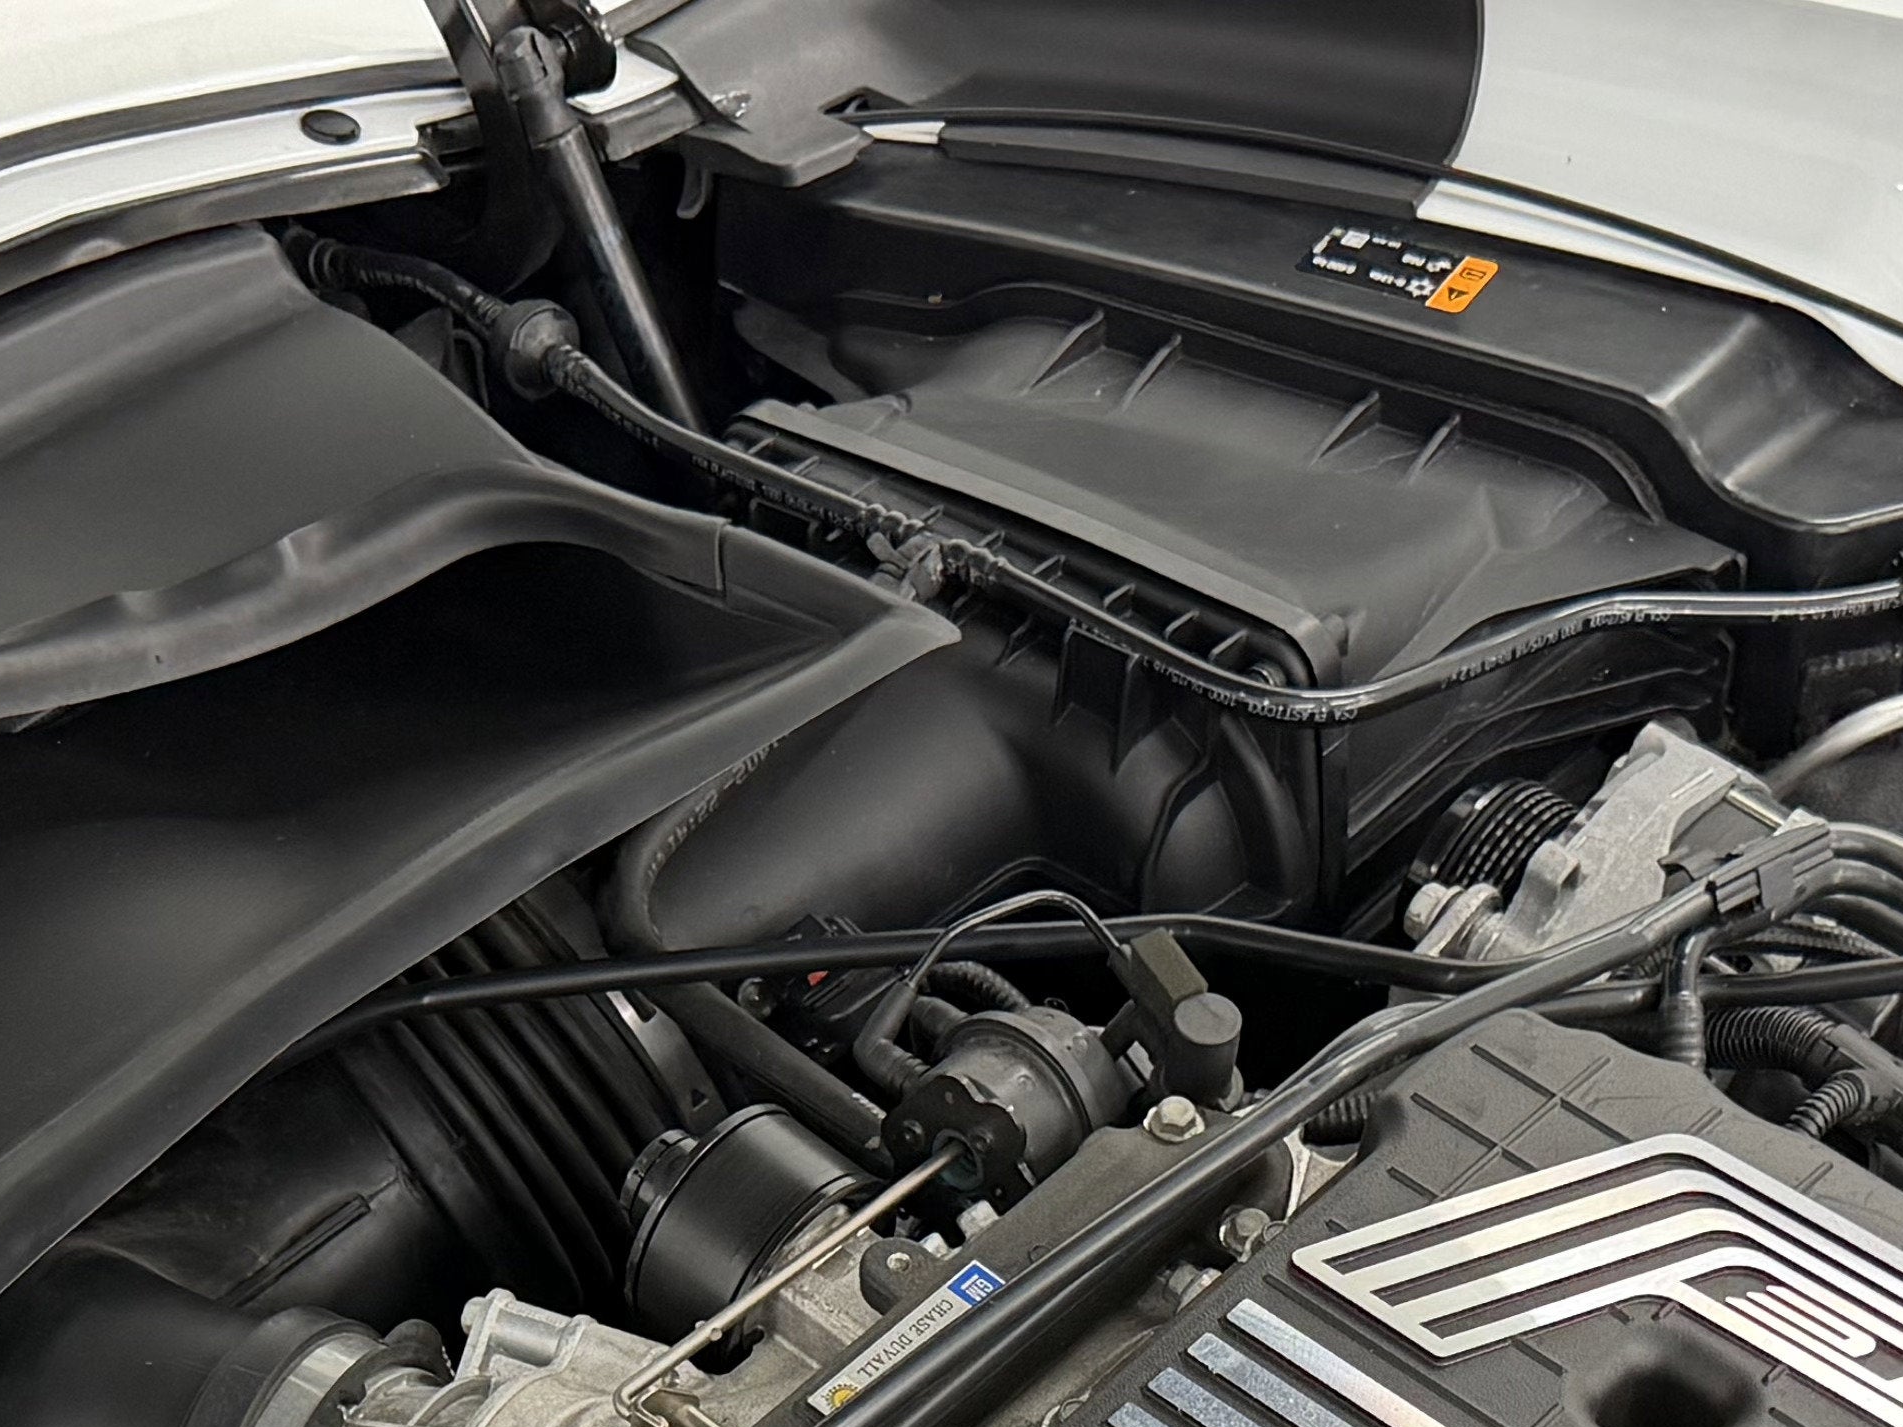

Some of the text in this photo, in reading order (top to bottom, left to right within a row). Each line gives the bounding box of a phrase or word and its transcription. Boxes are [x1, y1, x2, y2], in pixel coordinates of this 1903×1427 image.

[960, 1275, 994, 1301] GM
[857, 1298, 954, 1378] CHASE DUVALL
